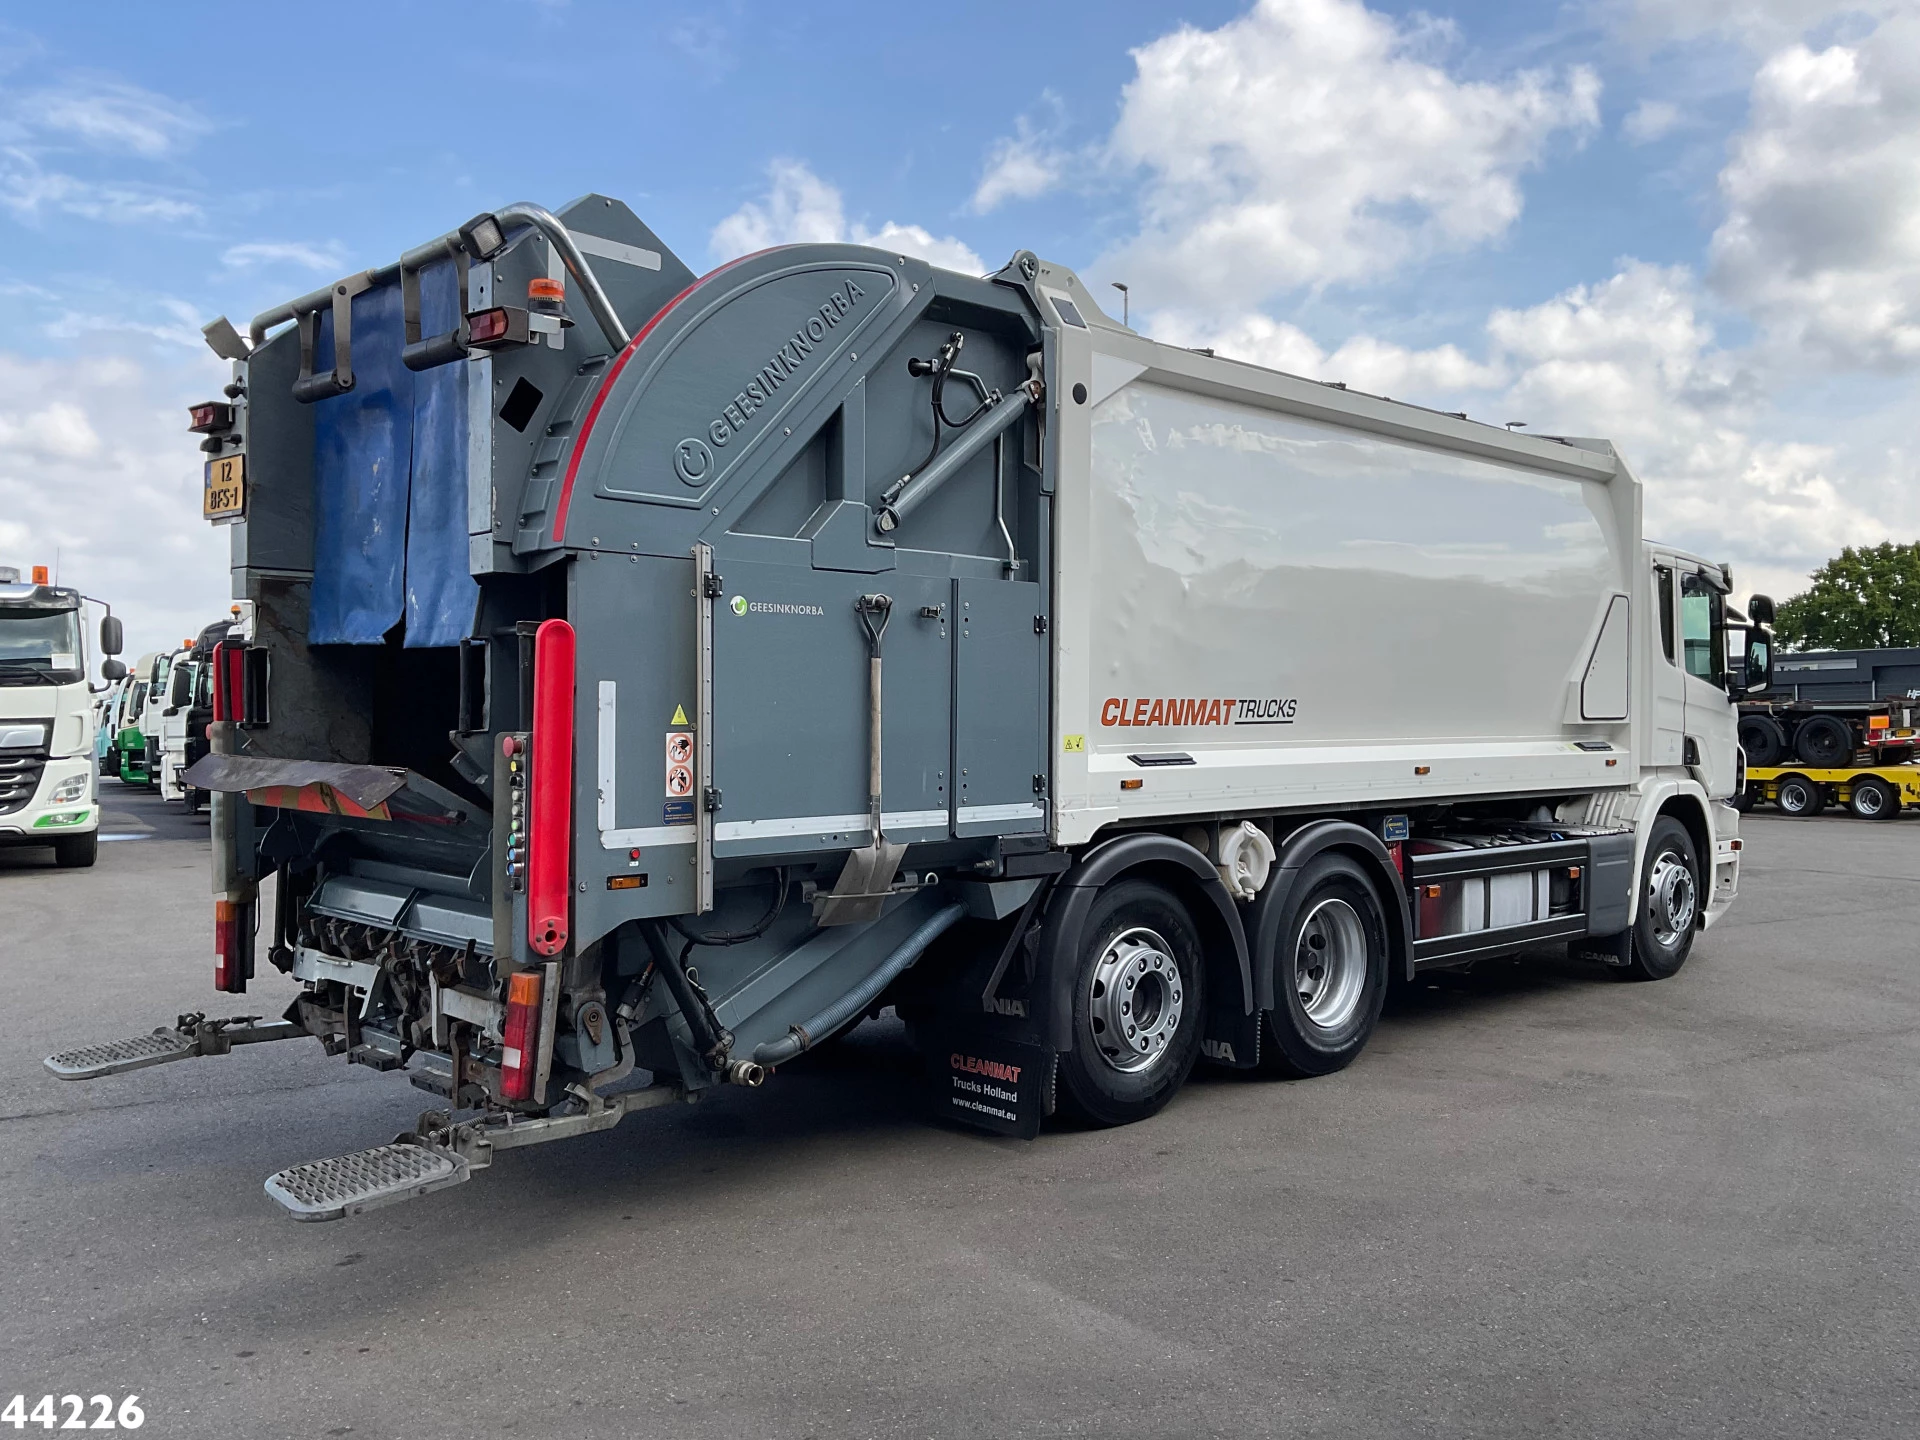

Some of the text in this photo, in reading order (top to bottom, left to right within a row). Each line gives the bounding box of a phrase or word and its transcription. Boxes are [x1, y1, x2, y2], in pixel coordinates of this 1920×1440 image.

[708, 279, 866, 447] GEESINKNORBA
[221, 461, 232, 483] 12
[210, 486, 238, 510] BFS-1
[749, 602, 824, 616] GEESINKNORBA
[1100, 697, 1297, 727] CLEANMAT TRUCKS
[950, 1053, 1022, 1083] CLEANMAT
[952, 1076, 1018, 1103] Trucks Holland
[952, 1097, 1017, 1122] www.cleanmat.eu
